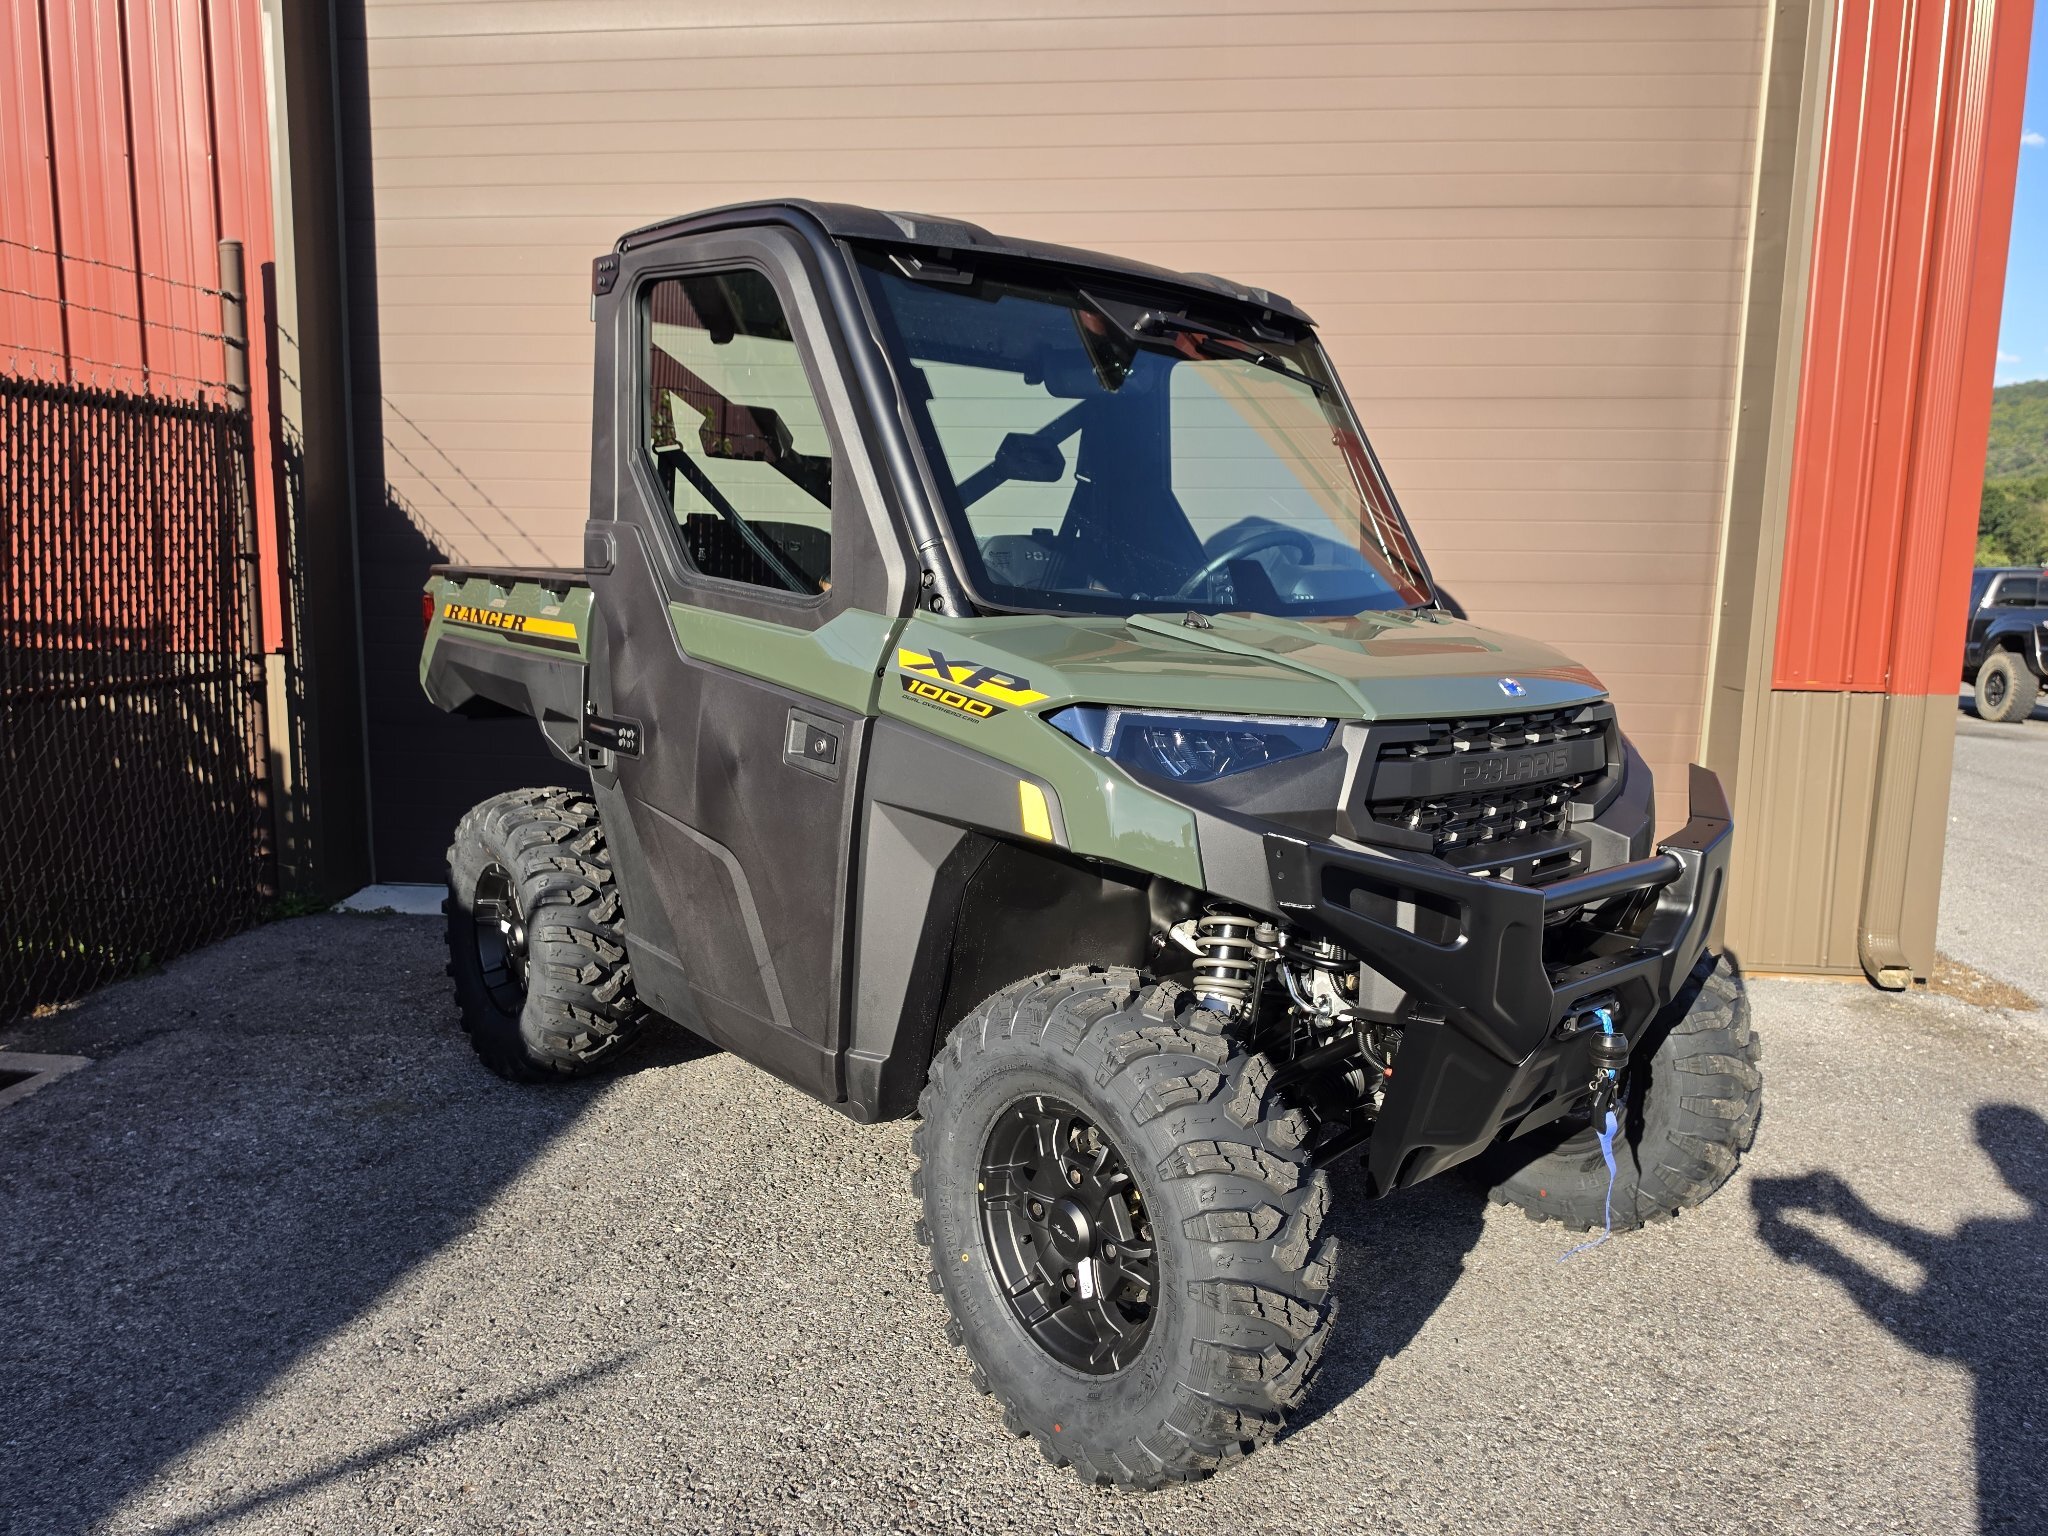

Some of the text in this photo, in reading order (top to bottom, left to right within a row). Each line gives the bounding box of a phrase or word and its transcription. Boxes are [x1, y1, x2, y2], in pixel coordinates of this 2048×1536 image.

[447, 604, 527, 631] RANGER
[903, 648, 1033, 691] XP
[902, 694, 980, 725] DUAL OVERHEAD CAM
[907, 679, 994, 717] 1000
[1459, 747, 1569, 787] POLARIS
